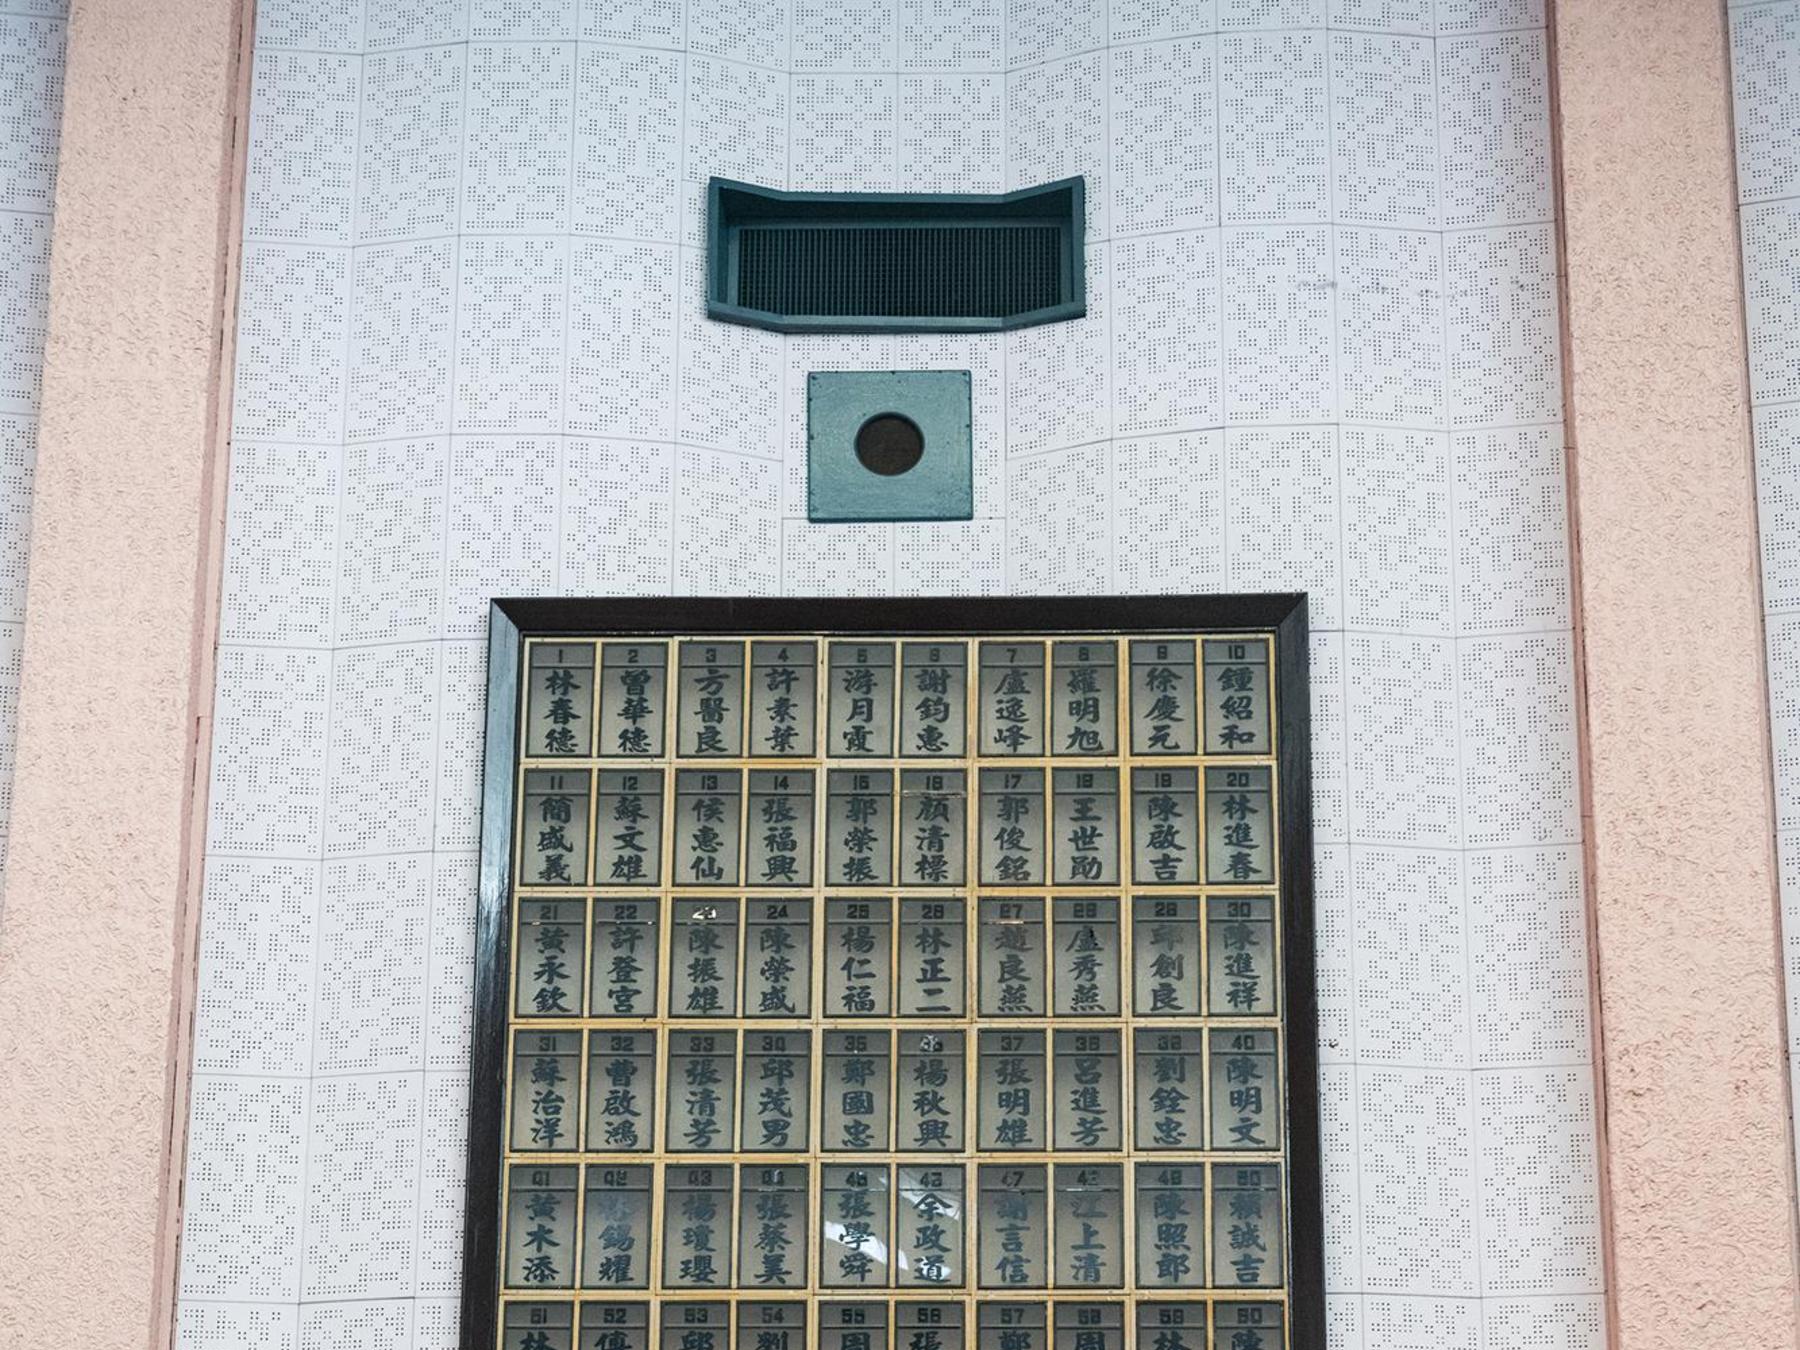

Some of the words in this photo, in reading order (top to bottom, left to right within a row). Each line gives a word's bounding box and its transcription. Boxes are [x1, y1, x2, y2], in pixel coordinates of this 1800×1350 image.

[627, 648, 639, 664] 2
[705, 648, 717, 664] 3
[777, 648, 788, 664] 4
[1006, 647, 1017, 662] 7
[1228, 646, 1245, 661] 10
[544, 668, 581, 754] 林春德
[617, 670, 653, 754] 曾華德
[694, 668, 730, 754] 方醫良
[765, 668, 799, 754] 許素葉
[842, 668, 877, 753] 游月霞
[915, 666, 951, 753] 謝鈞惠
[1065, 666, 1103, 753] 羅明旭
[550, 775, 563, 791] 11
[622, 775, 639, 791] 12
[700, 775, 718, 791] 13
[773, 775, 790, 791] 14
[1003, 773, 1021, 790] 17
[1226, 773, 1250, 790] 20
[610, 796, 648, 883] 蘇文雄
[690, 798, 724, 883] 侯惠仙
[761, 796, 799, 883] 張福興
[843, 796, 879, 883] 郭榮振
[991, 794, 1032, 882] 郭俊銘
[1222, 794, 1265, 882] 林進春
[539, 904, 558, 921] 21
[614, 904, 638, 921] 22
[766, 904, 789, 921] 24
[1227, 902, 1252, 919] 30
[686, 927, 724, 1014] 陳振雄
[759, 926, 796, 1014] 陳榮盛
[840, 926, 876, 1012] 楊仁福
[915, 923, 952, 1012] 林正二
[1065, 923, 1105, 1014] 盧秀燕
[538, 1035, 557, 1052] 31
[610, 1035, 634, 1052] 32
[689, 1035, 715, 1052] 33
[1000, 1035, 1025, 1052] 37
[1230, 1035, 1256, 1052] 40
[530, 1059, 566, 1149] 蘇治洋
[683, 1057, 722, 1149] 張清芳
[758, 1057, 797, 1149] 邱茂男
[842, 1059, 875, 1149] 鄭國忠
[912, 1056, 952, 1147] 楊秋興
[994, 1056, 1037, 1148] 張明雄
[1070, 1056, 1112, 1148] 呂進芳
[1227, 1056, 1268, 1148] 陳明文
[598, 1194, 635, 1285] 錫耀
[838, 1192, 875, 1285] 張學舜
[1154, 1192, 1191, 1284] 陳照郎
[602, 1307, 627, 1324] 52
[761, 1307, 785, 1324] 54
